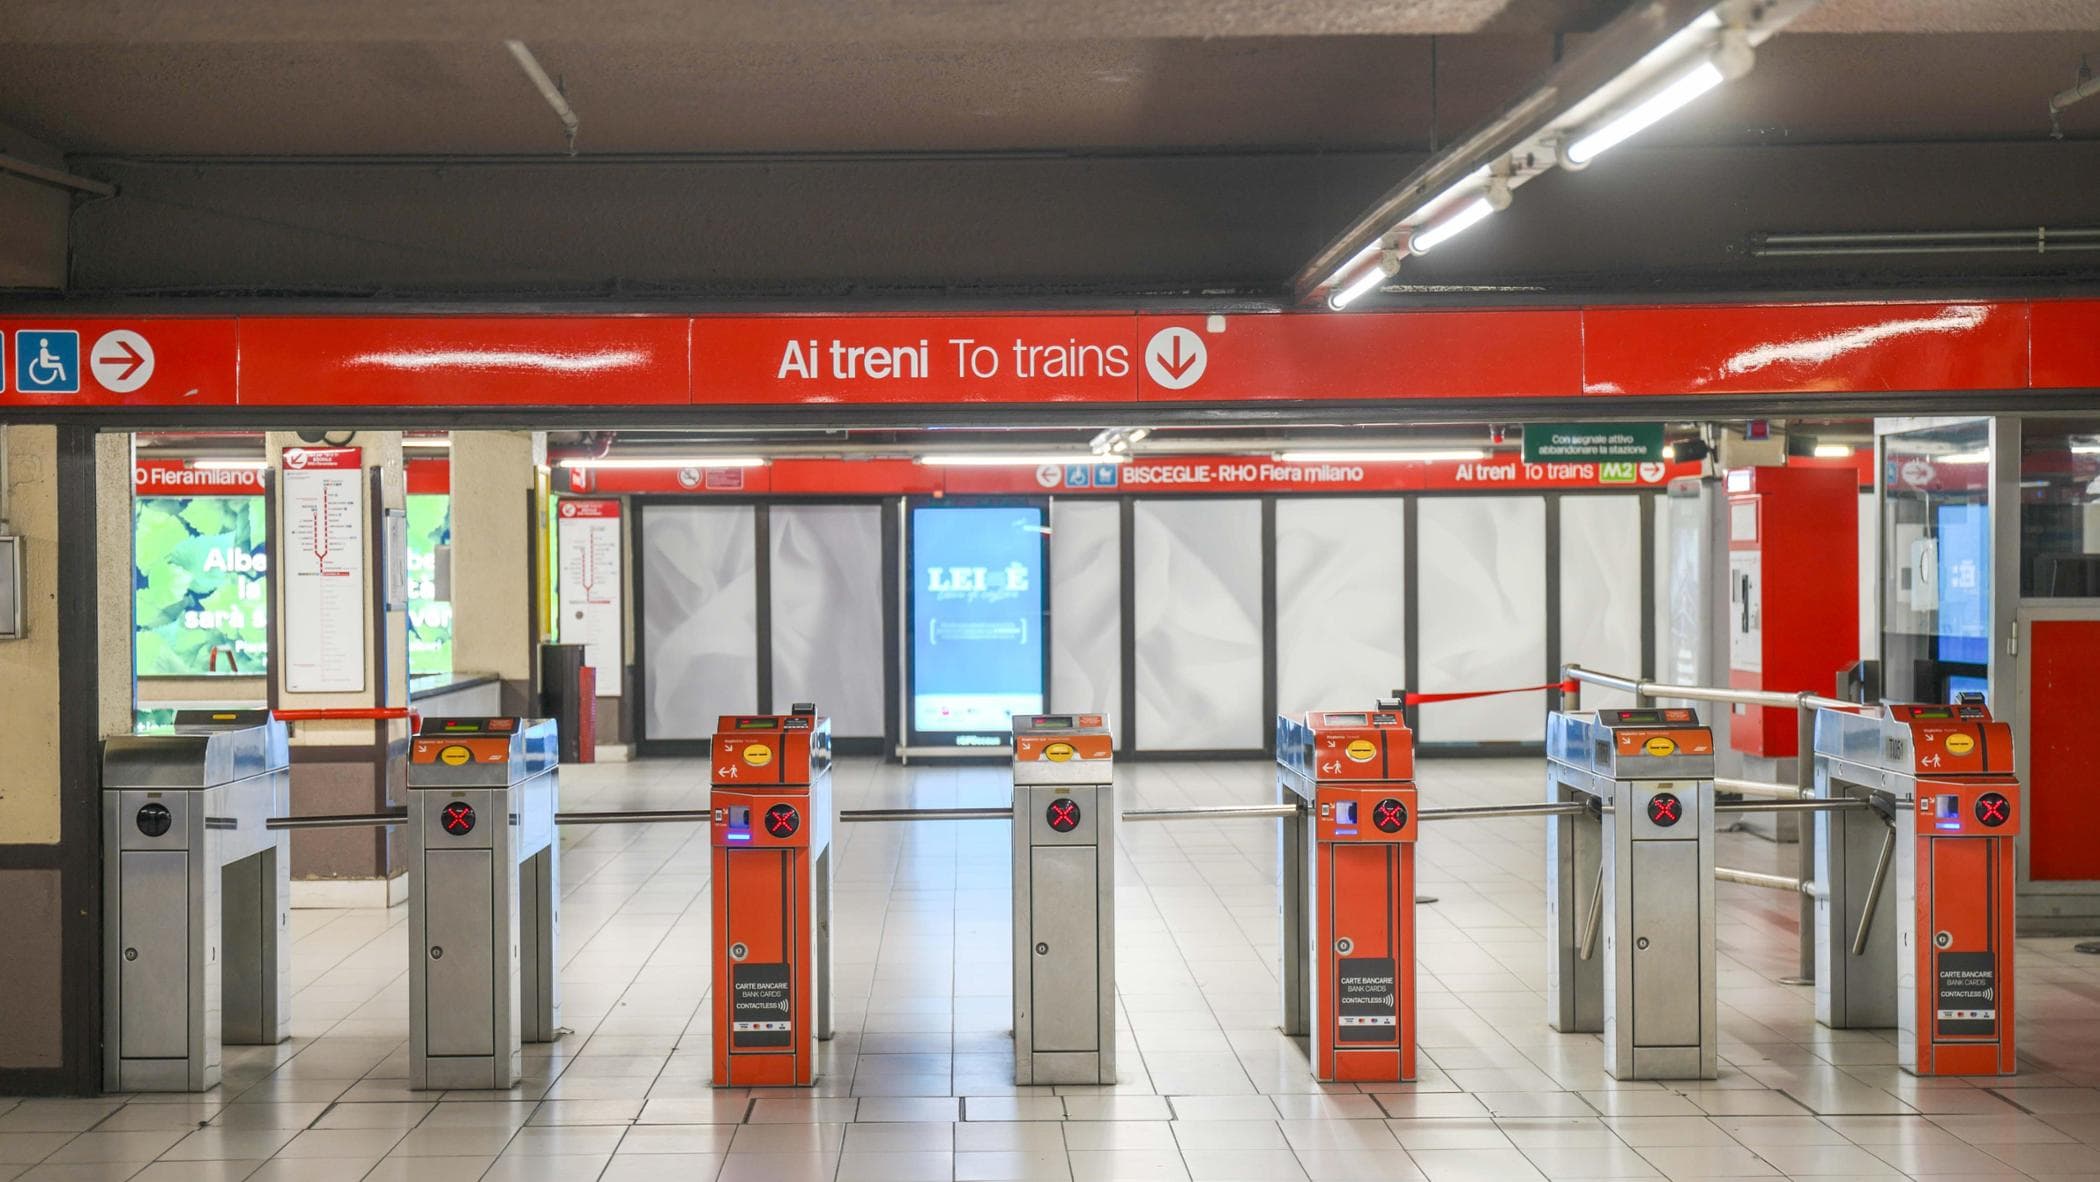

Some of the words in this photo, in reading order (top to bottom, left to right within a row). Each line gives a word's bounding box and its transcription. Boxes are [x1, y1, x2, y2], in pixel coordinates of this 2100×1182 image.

[777, 339, 818, 379] Ai
[829, 339, 928, 379] treni
[948, 339, 1000, 379] To
[1012, 339, 1130, 379] trains
[1551, 434, 1571, 445] Con
[1572, 435, 1607, 446] segnale
[1608, 435, 1634, 445] attivo
[1538, 445, 1598, 455] abbandonare
[1599, 445, 1608, 455] la
[1608, 445, 1648, 455] stazione
[1455, 463, 1474, 481] Ai
[1476, 463, 1517, 481] treni
[1525, 463, 1544, 480] To
[1547, 462, 1595, 480] trains
[1602, 462, 1634, 478] M2
[1341, 977, 1361, 985] CARTE
[1362, 977, 1393, 985] BANCARIE
[735, 982, 756, 990] CARTE
[757, 982, 789, 990] BANCARIE
[1347, 985, 1364, 993] BANK
[1365, 985, 1387, 993] CARDS
[742, 990, 759, 998] BANK
[760, 990, 781, 998] CARDS
[1940, 990, 1982, 998] CONTACTLESS
